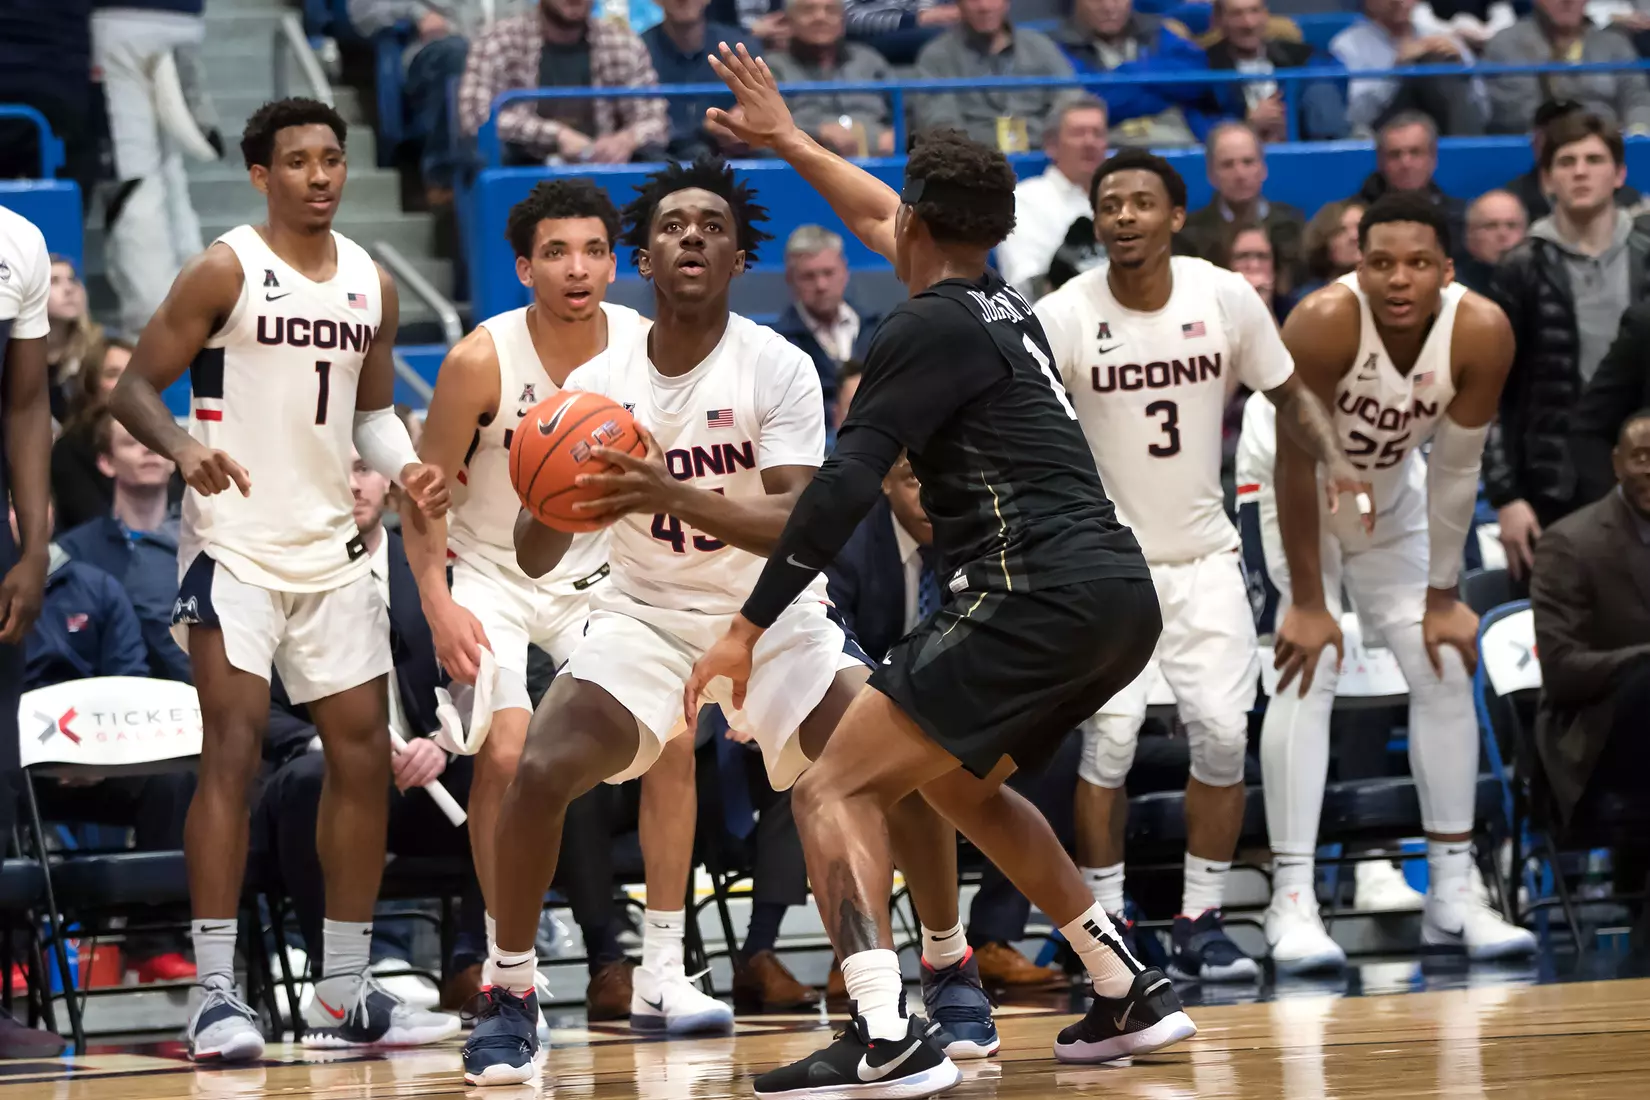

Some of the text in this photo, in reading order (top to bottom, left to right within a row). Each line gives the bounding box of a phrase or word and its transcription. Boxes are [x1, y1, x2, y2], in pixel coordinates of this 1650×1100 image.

[966, 290, 1025, 323] JOHNSN
[257, 315, 378, 353] UCONN
[314, 360, 332, 425] 1
[1091, 352, 1222, 393] UCONN
[1145, 400, 1181, 458] 3
[665, 440, 756, 481] ONN
[1344, 430, 1411, 470] 25
[92, 707, 201, 727] TICKET
